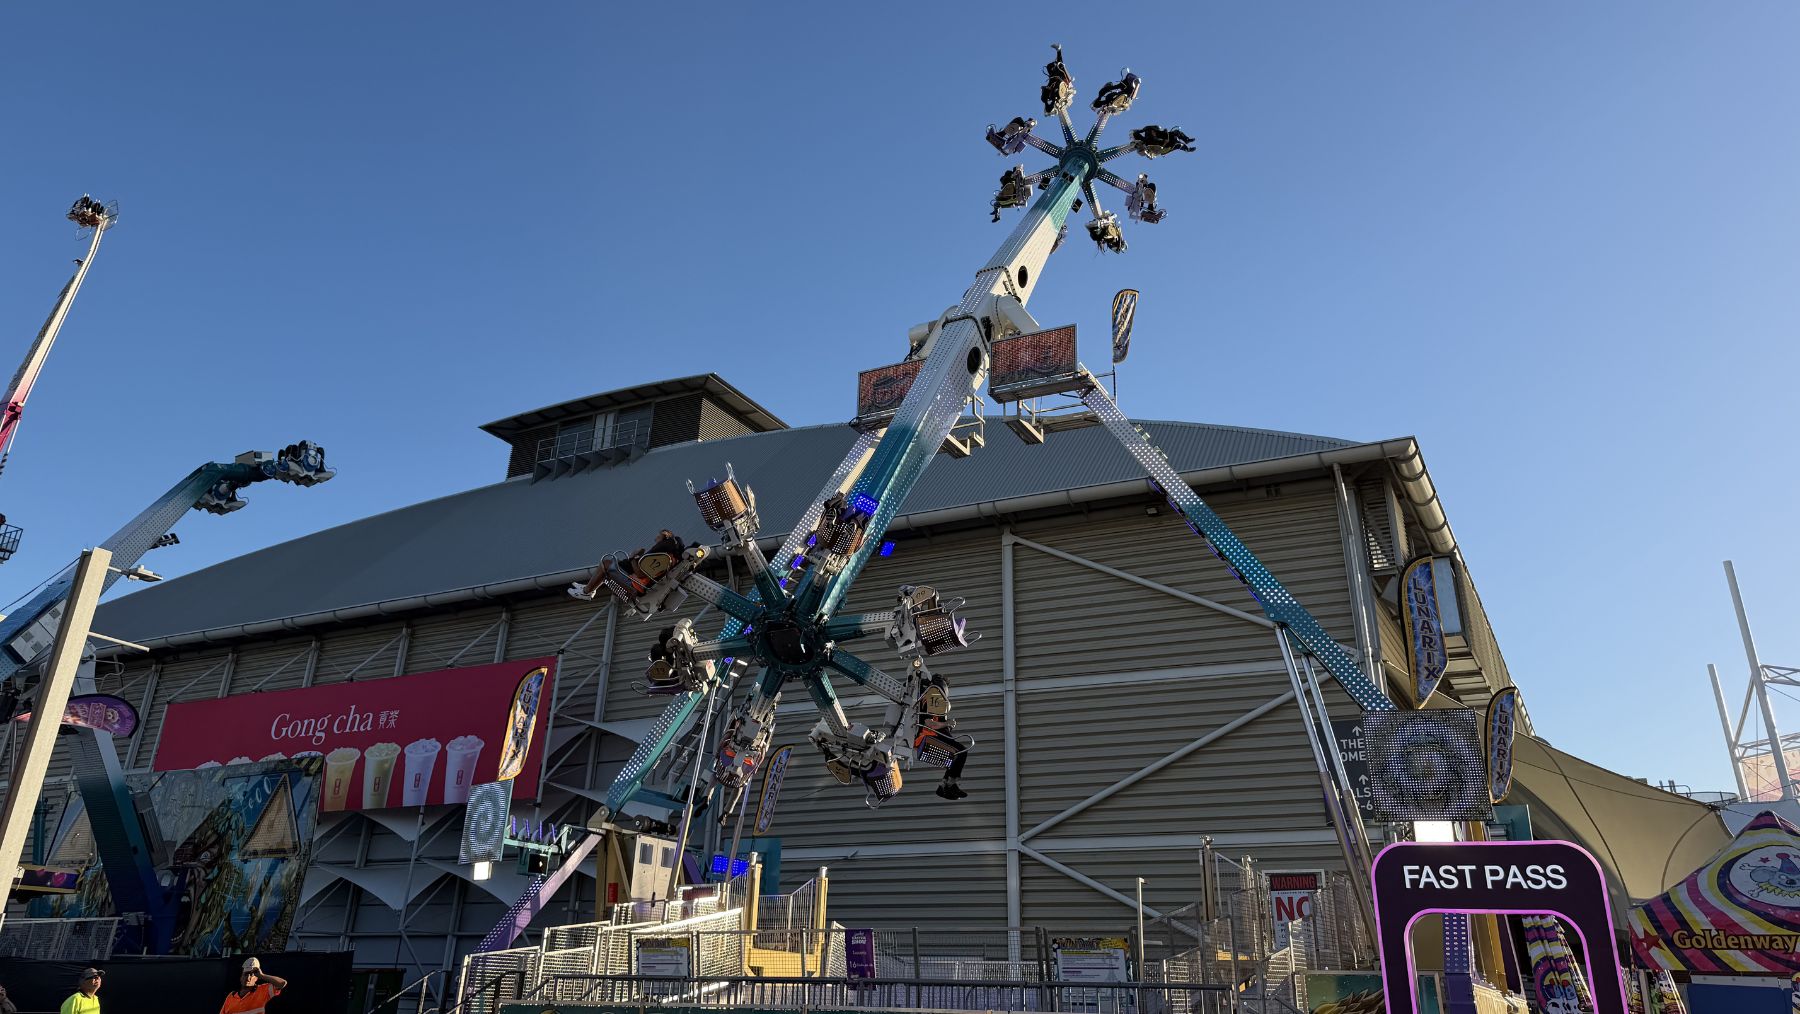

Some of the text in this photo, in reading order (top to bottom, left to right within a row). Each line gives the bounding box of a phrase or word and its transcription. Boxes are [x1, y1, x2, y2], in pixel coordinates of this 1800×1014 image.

[1411, 577, 1441, 681] LUNARIX
[271, 704, 374, 746] Gong cha
[1340, 738, 1366, 749] THE
[1340, 750, 1367, 762] OME
[1496, 703, 1510, 785] LUNARIX
[1271, 875, 1316, 890] WARNING
[1403, 864, 1568, 890] FAST PASS
[1672, 929, 1798, 954] Goldenway
